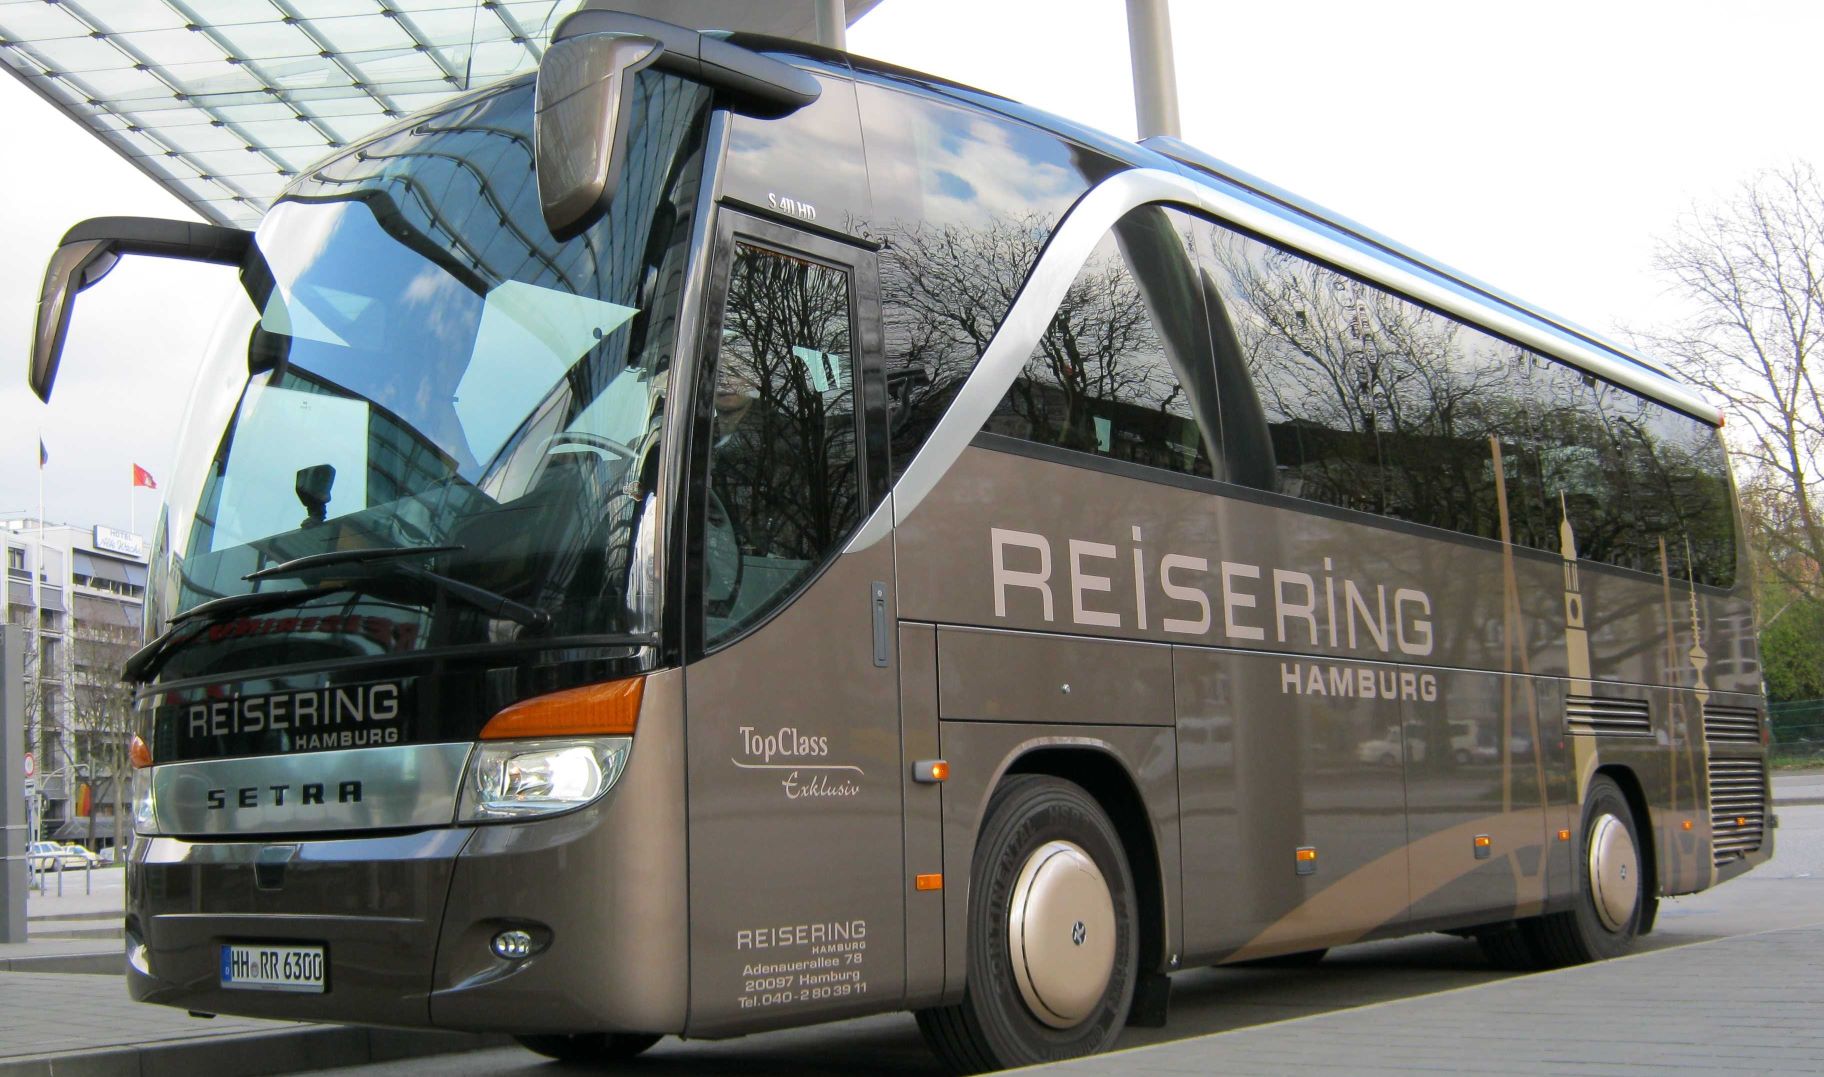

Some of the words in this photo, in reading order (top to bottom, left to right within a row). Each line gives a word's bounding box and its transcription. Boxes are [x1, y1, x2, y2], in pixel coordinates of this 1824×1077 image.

[768, 192, 777, 209] S
[797, 202, 816, 220] HD
[1281, 663, 1438, 702] HAMBURG
[296, 727, 399, 750] HAMBURG
[739, 726, 828, 763] TopClass
[207, 780, 363, 810] SETRA
[782, 771, 860, 799] Exklusiv
[737, 920, 866, 950] REISERING
[812, 941, 866, 955] HAMBURG
[231, 950, 250, 978] HH
[260, 951, 279, 980] RR
[284, 951, 323, 981] 6300
[742, 957, 840, 977] Adenauerallee
[844, 953, 863, 965] 78
[745, 976, 794, 992] 20097
[799, 970, 860, 986] Hamburg
